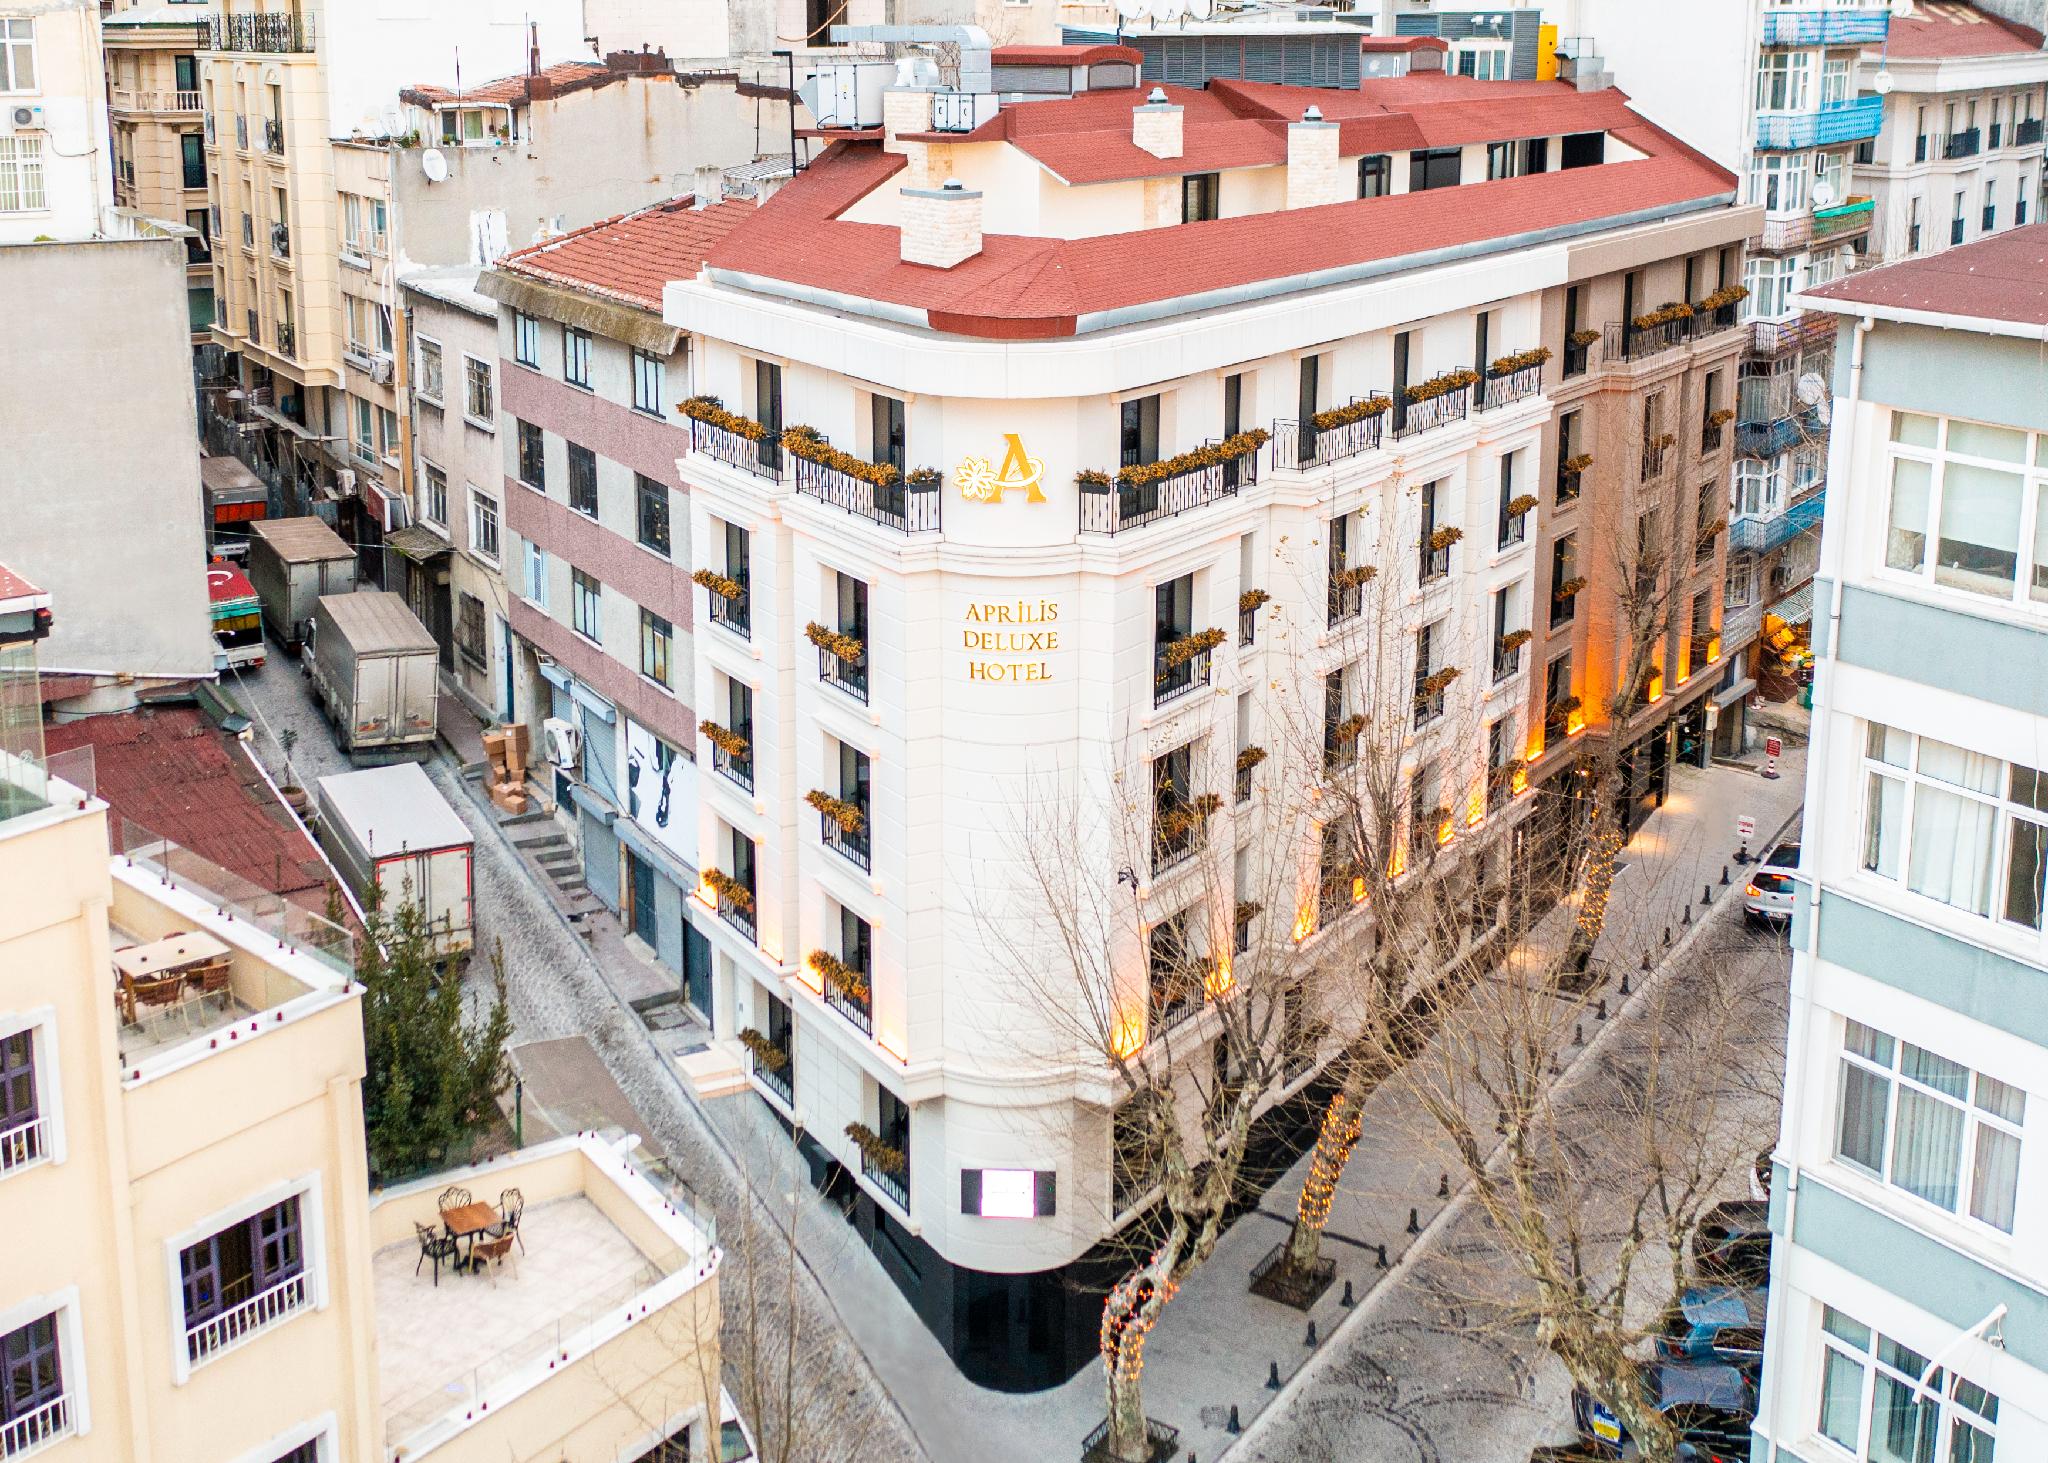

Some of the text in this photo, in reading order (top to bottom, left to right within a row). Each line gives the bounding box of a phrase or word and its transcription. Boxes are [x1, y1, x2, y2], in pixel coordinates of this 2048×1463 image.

[982, 433, 1047, 503] A
[965, 599, 1058, 623] APRİLİS
[963, 630, 1059, 650] DELUXE
[969, 661, 1053, 681] HOTEL
